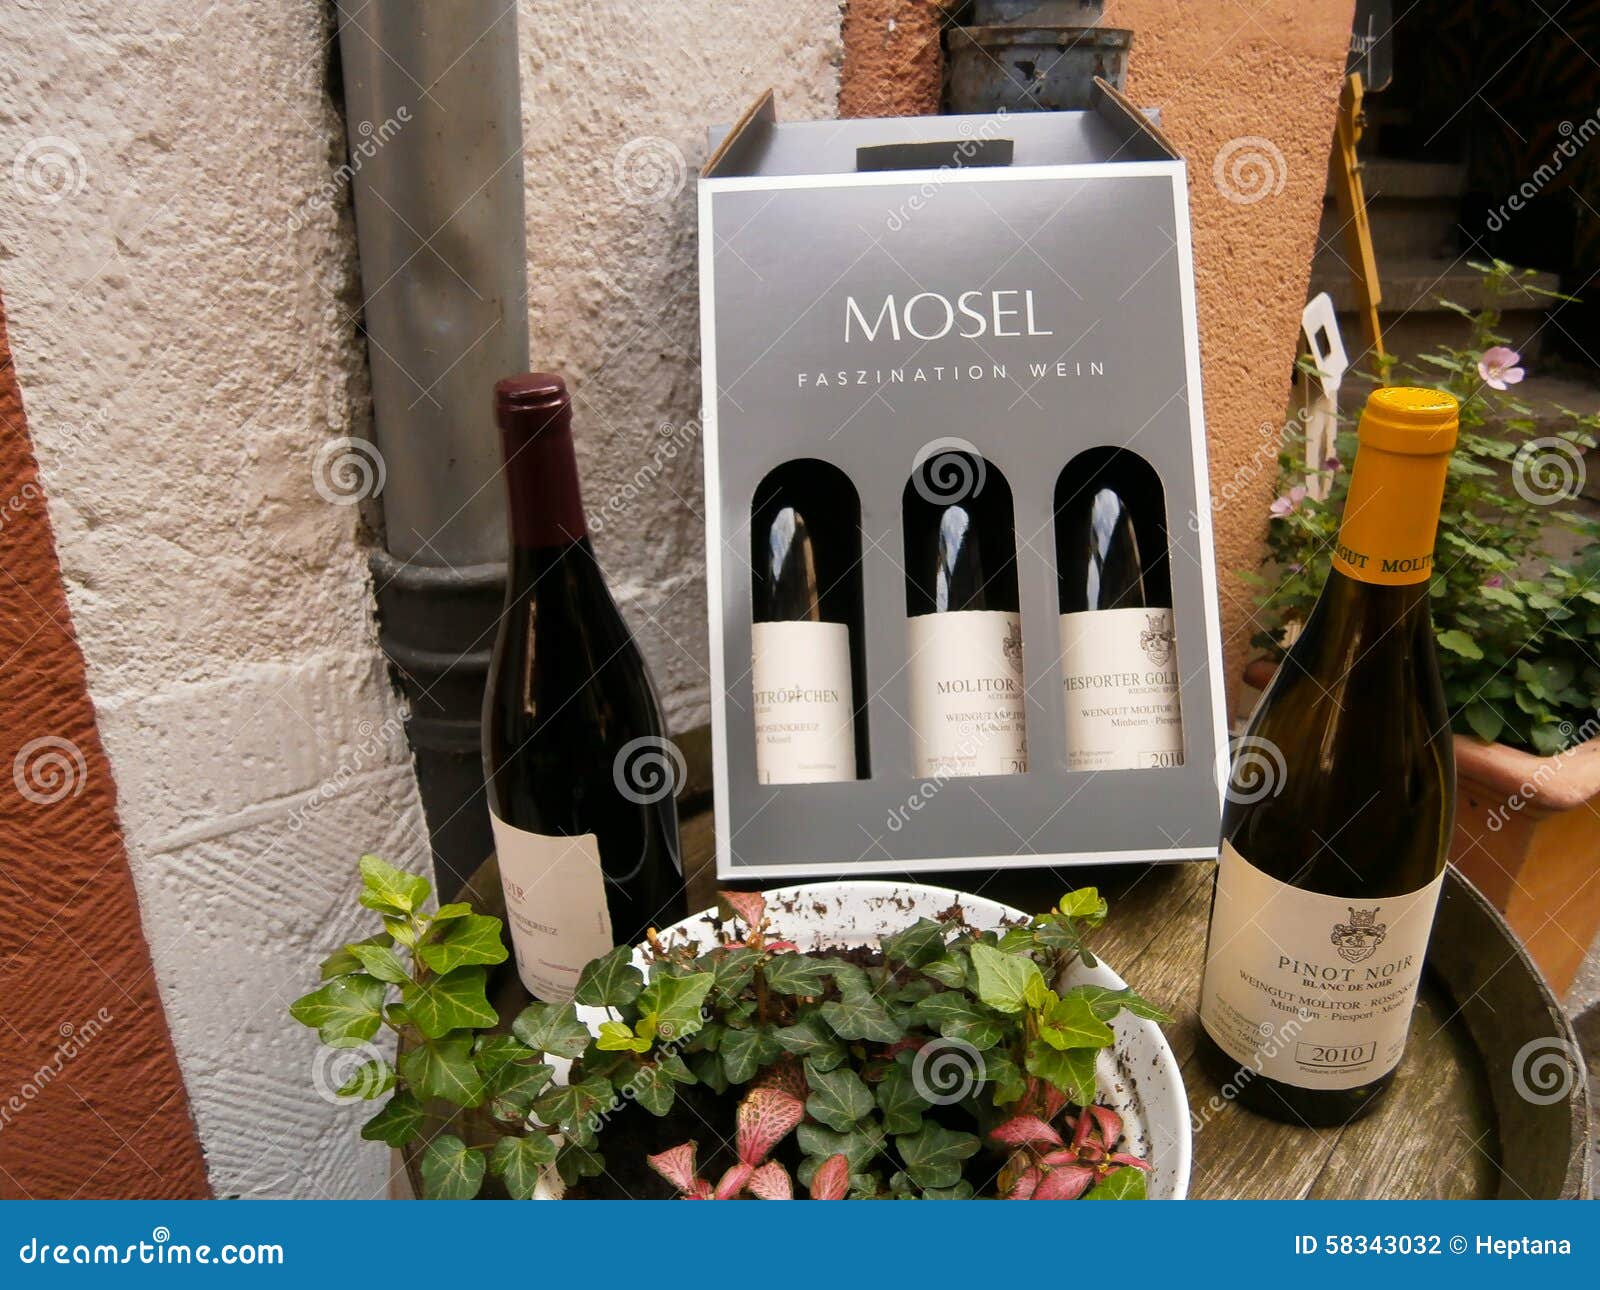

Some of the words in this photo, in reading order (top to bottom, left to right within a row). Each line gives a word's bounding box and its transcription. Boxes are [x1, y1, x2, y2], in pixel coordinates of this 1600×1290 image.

[845, 290, 1053, 343] MOSEL
[798, 364, 1006, 387] FASZINATION
[1030, 362, 1104, 377] WEIN
[1336, 544, 1369, 569] GUT
[937, 678, 1015, 695] MOLITOR
[1082, 706, 1128, 718] WEINGUT
[1131, 704, 1172, 715] MOLITOR
[1151, 752, 1184, 768] 2010
[1278, 956, 1355, 982] PINOT
[1365, 955, 1413, 980] NOIR
[1240, 969, 1295, 1001] WEINGUT
[1299, 996, 1361, 1010] MOLITOR
[1302, 979, 1344, 992] BLANC
[1348, 983, 1363, 992] DE
[1366, 978, 1392, 990] NOIR
[1331, 1010, 1373, 1022] Piesport
[1312, 1047, 1363, 1062] 2010
